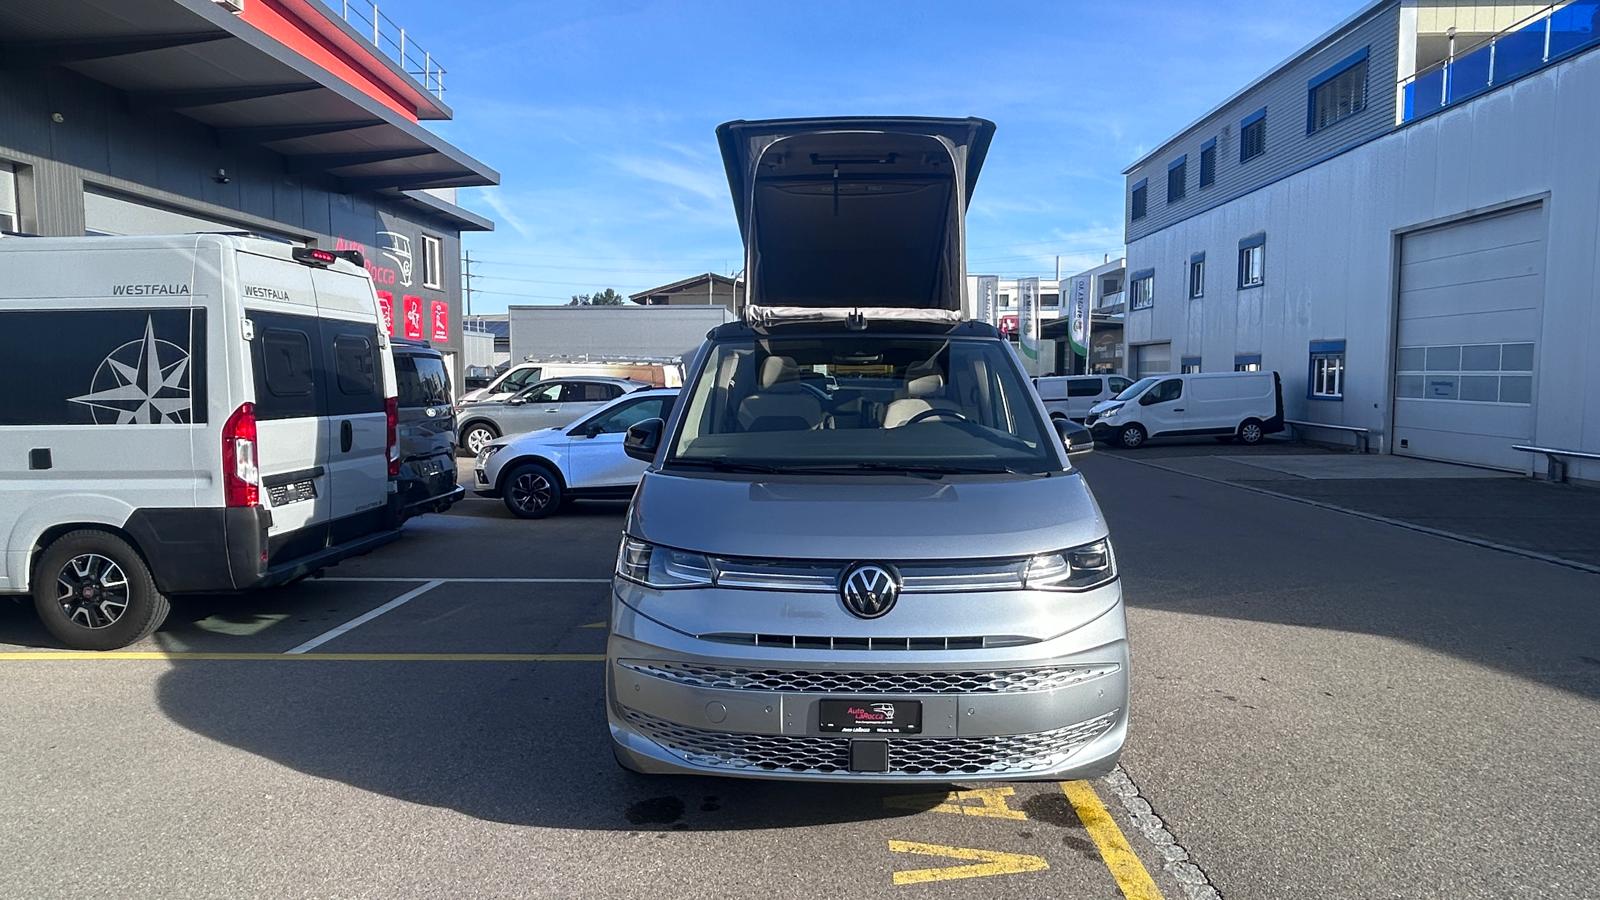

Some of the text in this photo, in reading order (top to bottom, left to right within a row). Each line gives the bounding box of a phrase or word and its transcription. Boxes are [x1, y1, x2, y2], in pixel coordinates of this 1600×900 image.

[113, 284, 190, 296] WESTFALIA
[245, 285, 290, 301] WESTFALIA
[847, 707, 865, 715] Auto
